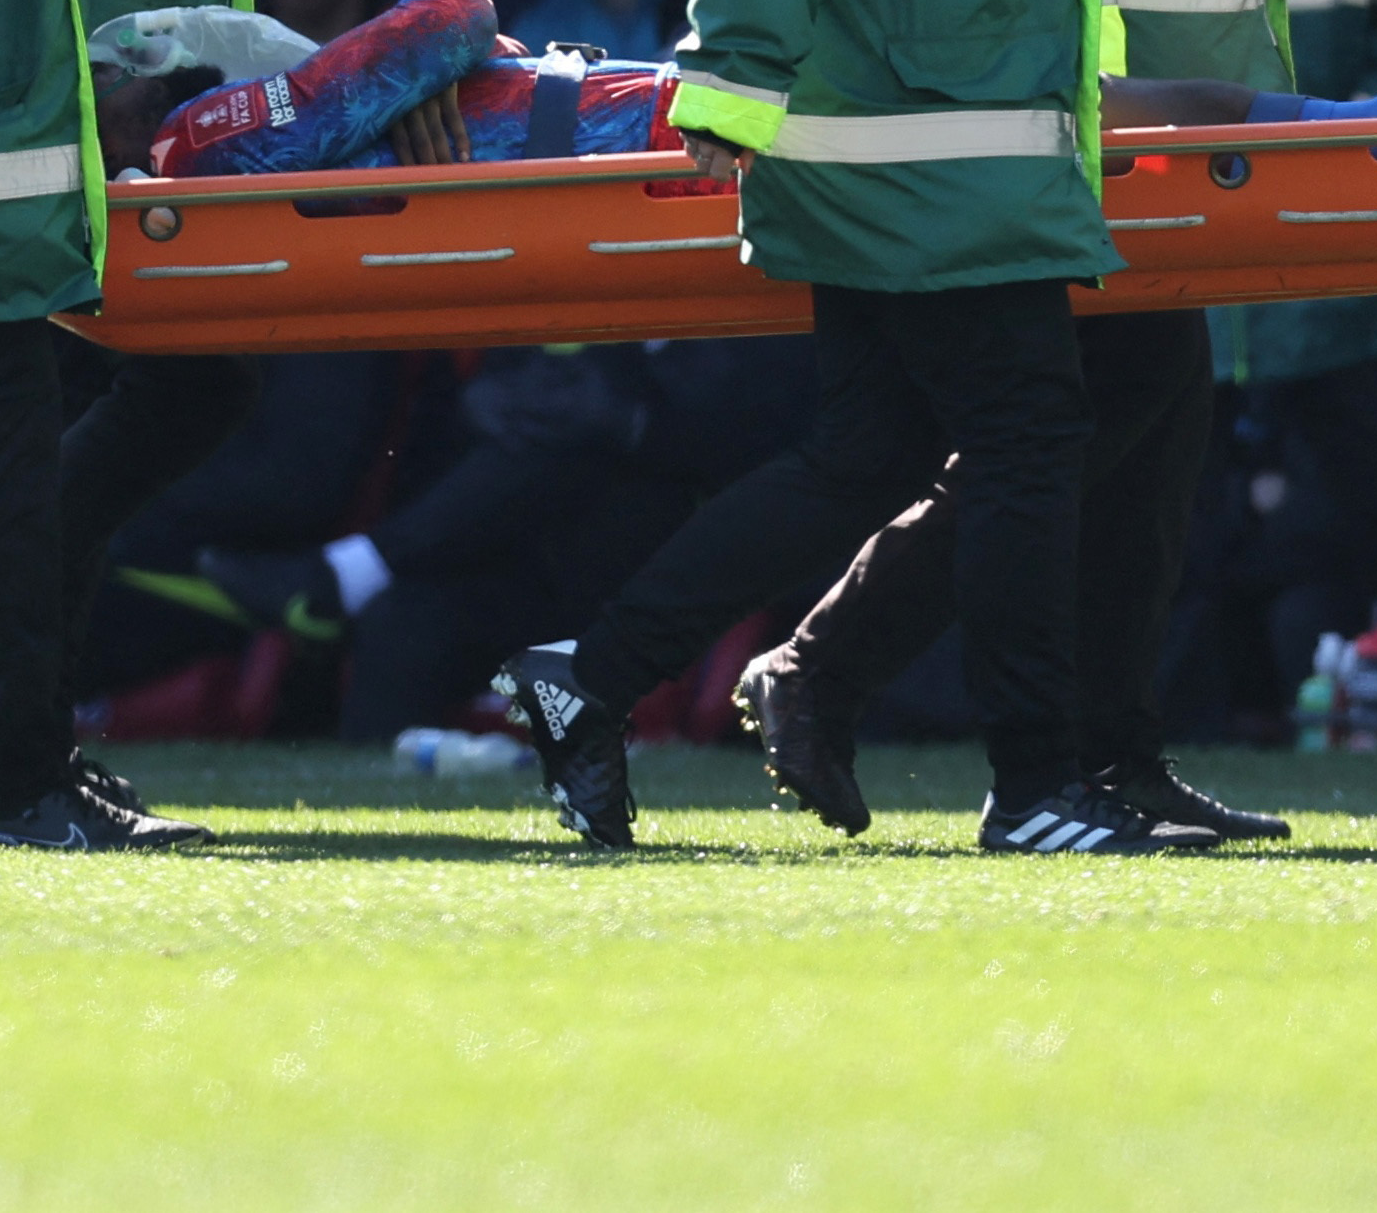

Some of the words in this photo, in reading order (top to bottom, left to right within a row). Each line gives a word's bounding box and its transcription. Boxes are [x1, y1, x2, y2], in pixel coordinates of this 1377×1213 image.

[237, 90, 249, 108] CUP
[264, 80, 280, 108] room
[240, 108, 251, 124] FA
[270, 109, 286, 127] No
[533, 679, 566, 741] adidas
